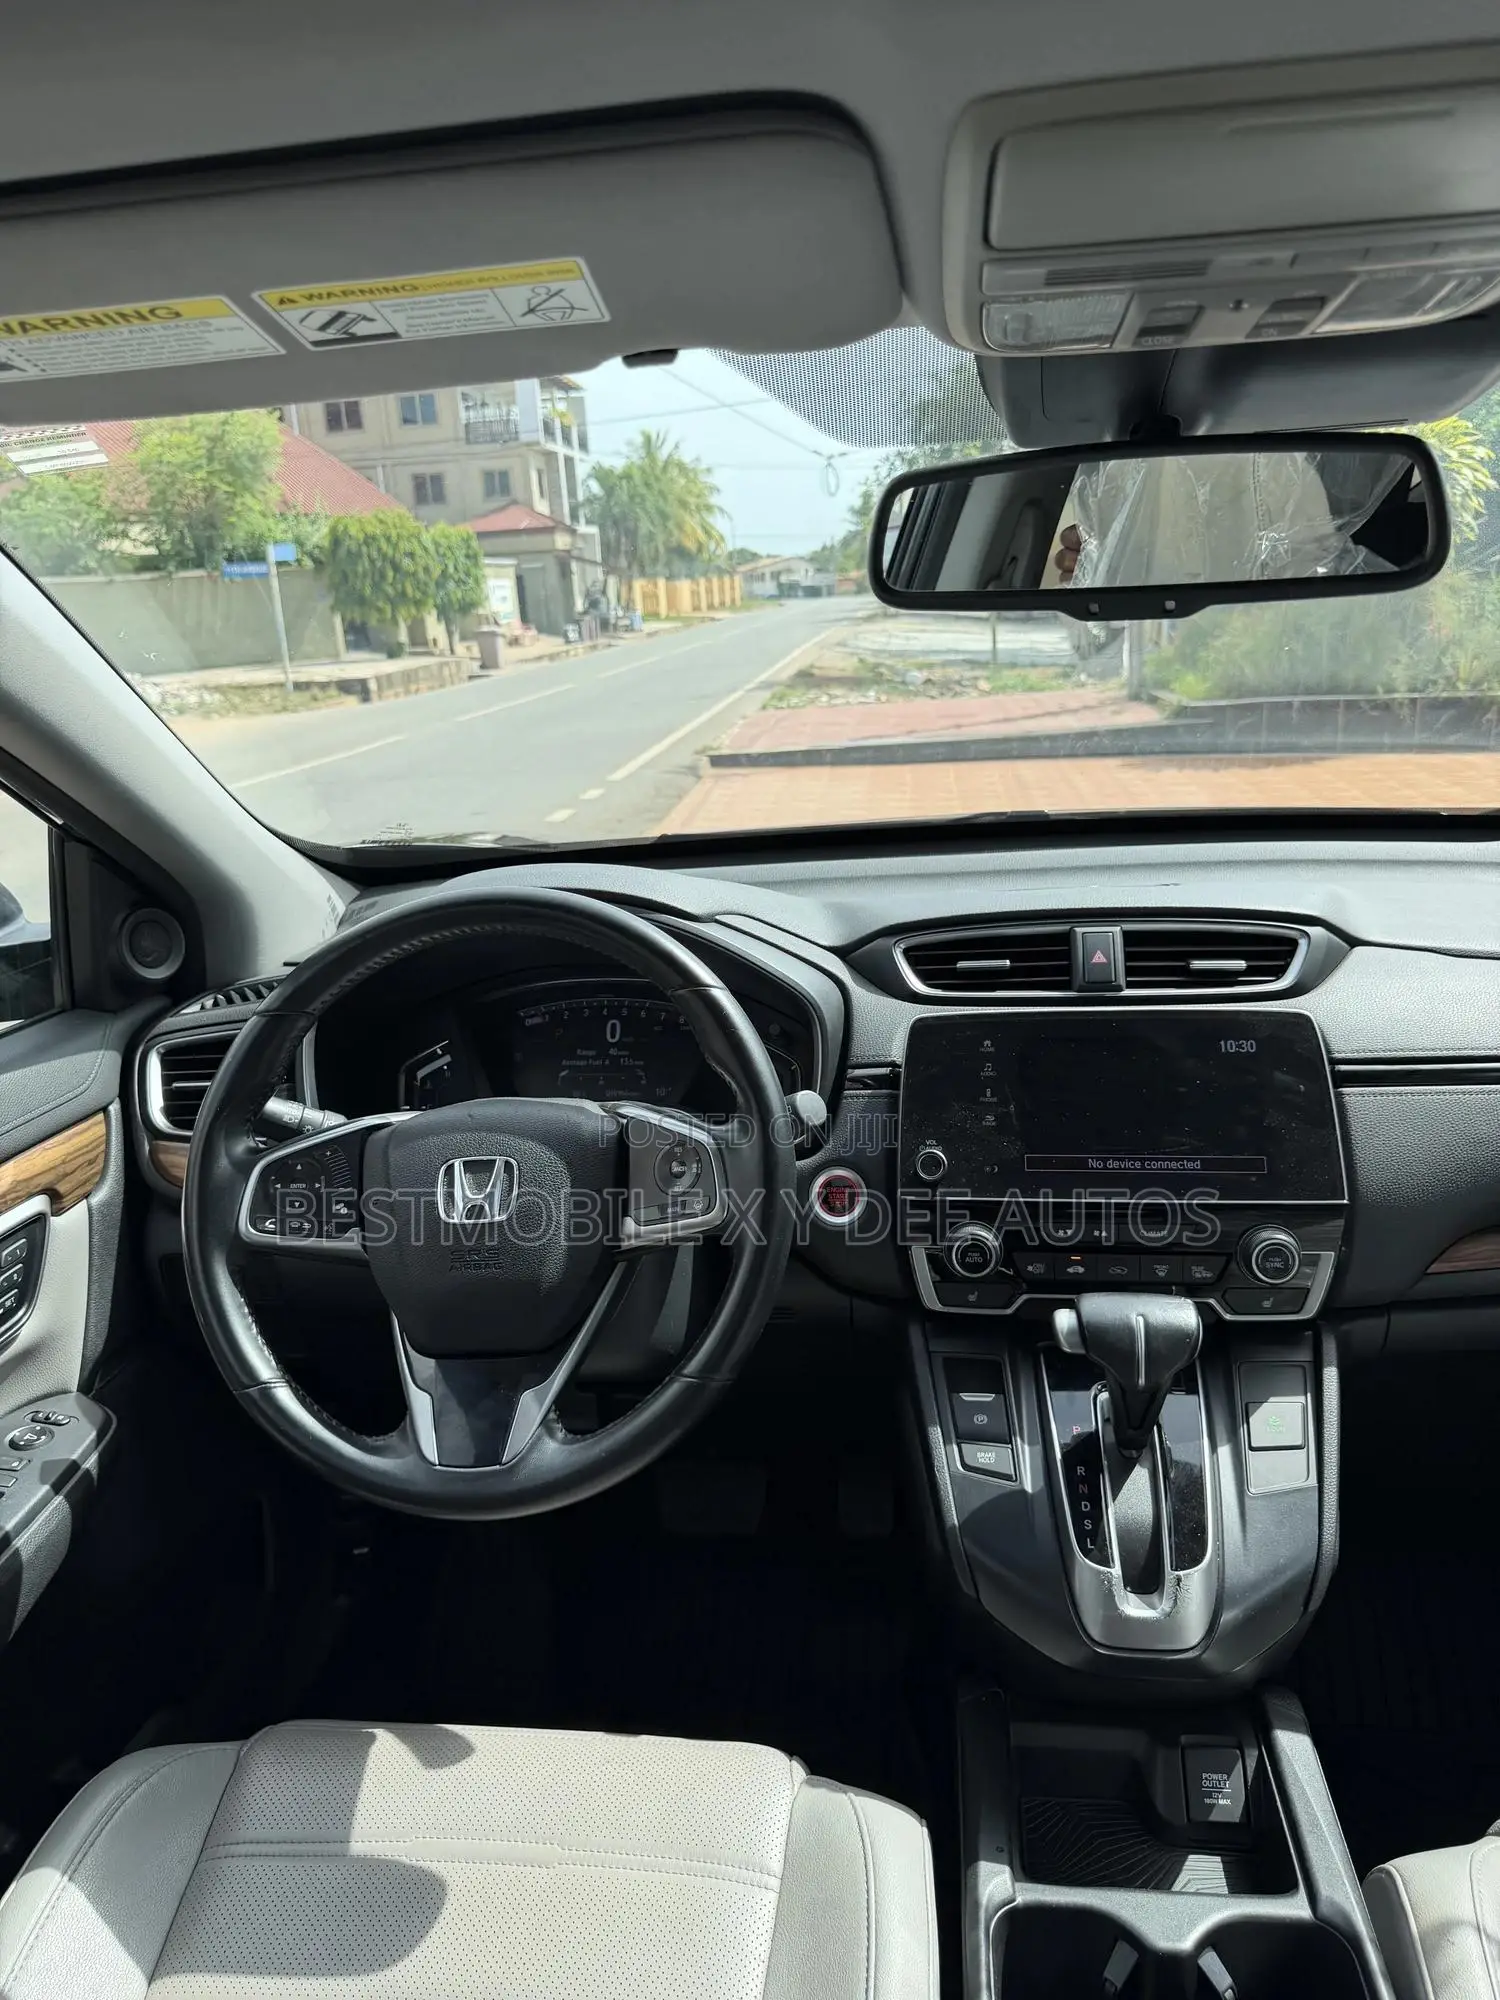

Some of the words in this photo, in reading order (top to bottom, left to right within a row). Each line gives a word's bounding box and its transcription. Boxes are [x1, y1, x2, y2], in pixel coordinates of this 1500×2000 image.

[299, 284, 420, 301] WARNING
[606, 1019, 621, 1043] 0
[1220, 1039, 1257, 1052] 10:30
[1088, 1158, 1104, 1169] No
[1106, 1158, 1142, 1169] device
[1144, 1158, 1201, 1169] connected
[1073, 1425, 1081, 1435] P
[1076, 1466, 1086, 1476] R
[1078, 1484, 1089, 1494] N
[1081, 1501, 1090, 1511] D
[1084, 1519, 1092, 1530] S
[1086, 1538, 1095, 1549] L
[1202, 1772, 1229, 1781] POWER
[1201, 1780, 1230, 1788] OUTLET
